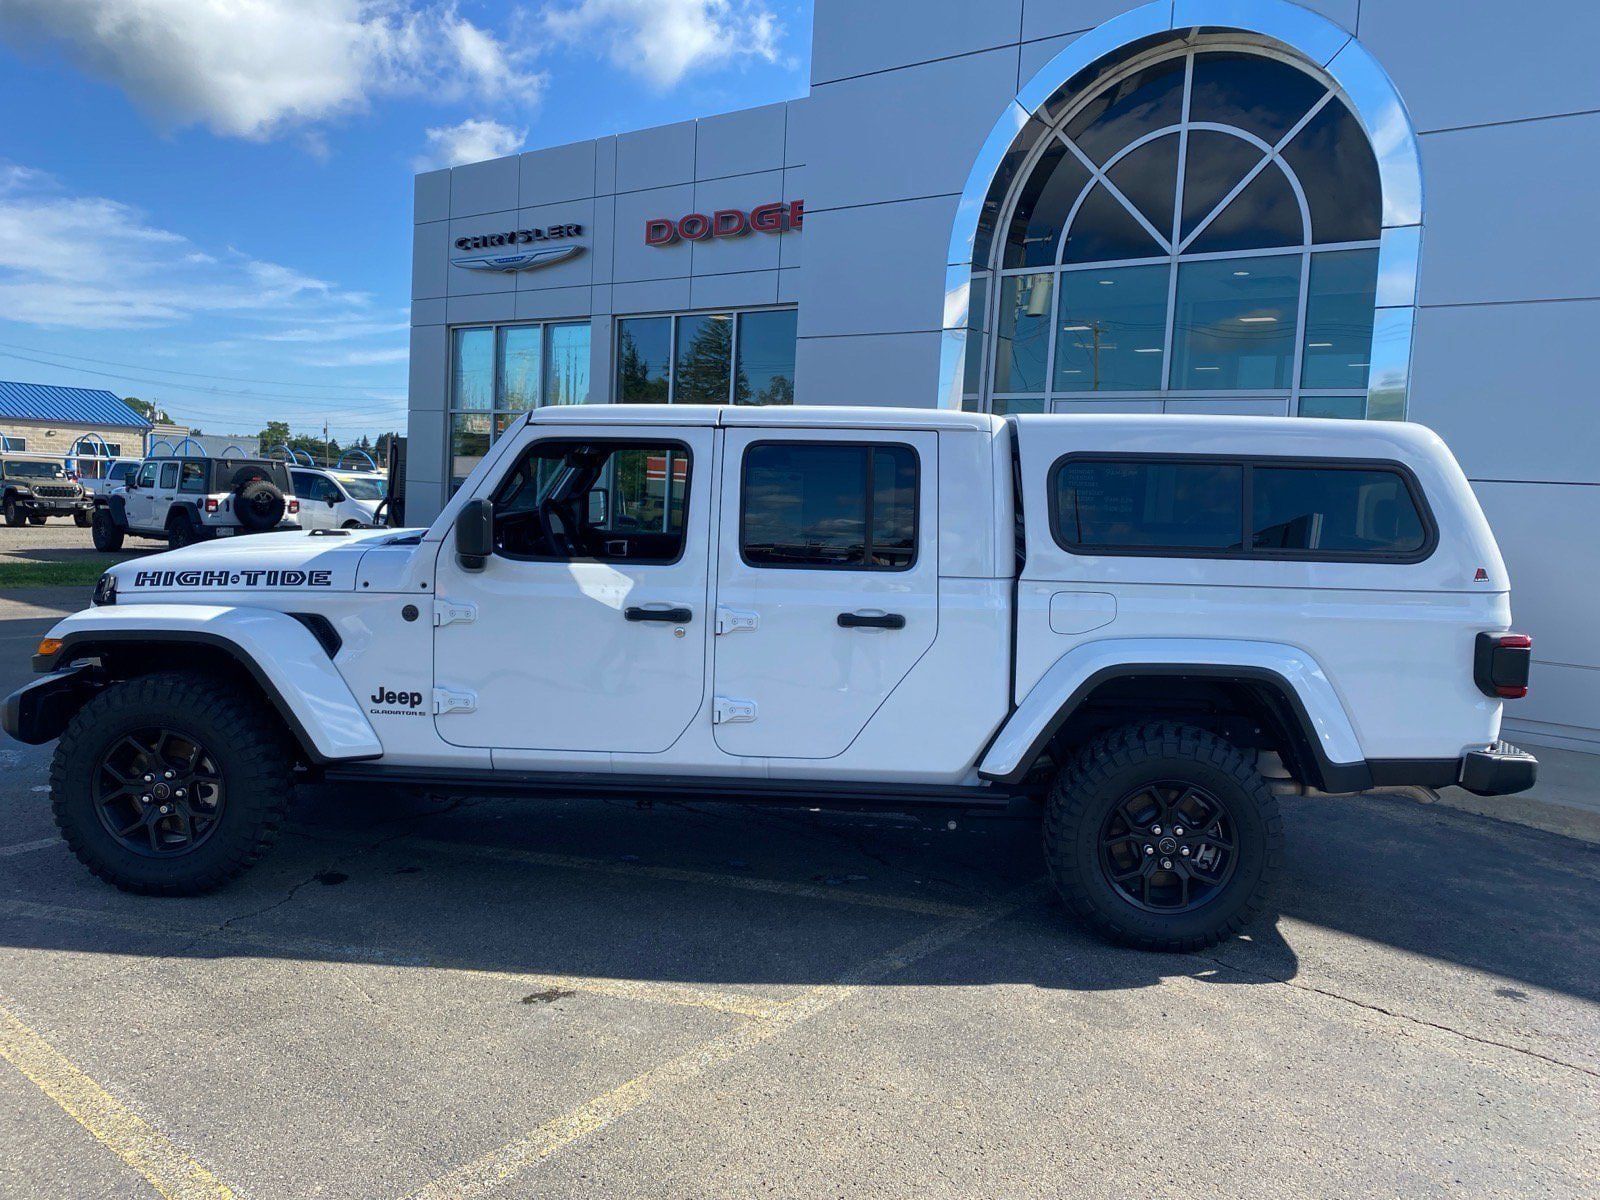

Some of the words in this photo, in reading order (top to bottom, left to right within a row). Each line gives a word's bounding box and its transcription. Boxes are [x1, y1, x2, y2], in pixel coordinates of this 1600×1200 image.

[645, 199, 804, 247] DODGE
[455, 223, 582, 250] CHRYSLER
[134, 571, 230, 586] HIGH
[240, 570, 332, 586] TIDE
[371, 686, 423, 709] Jeep
